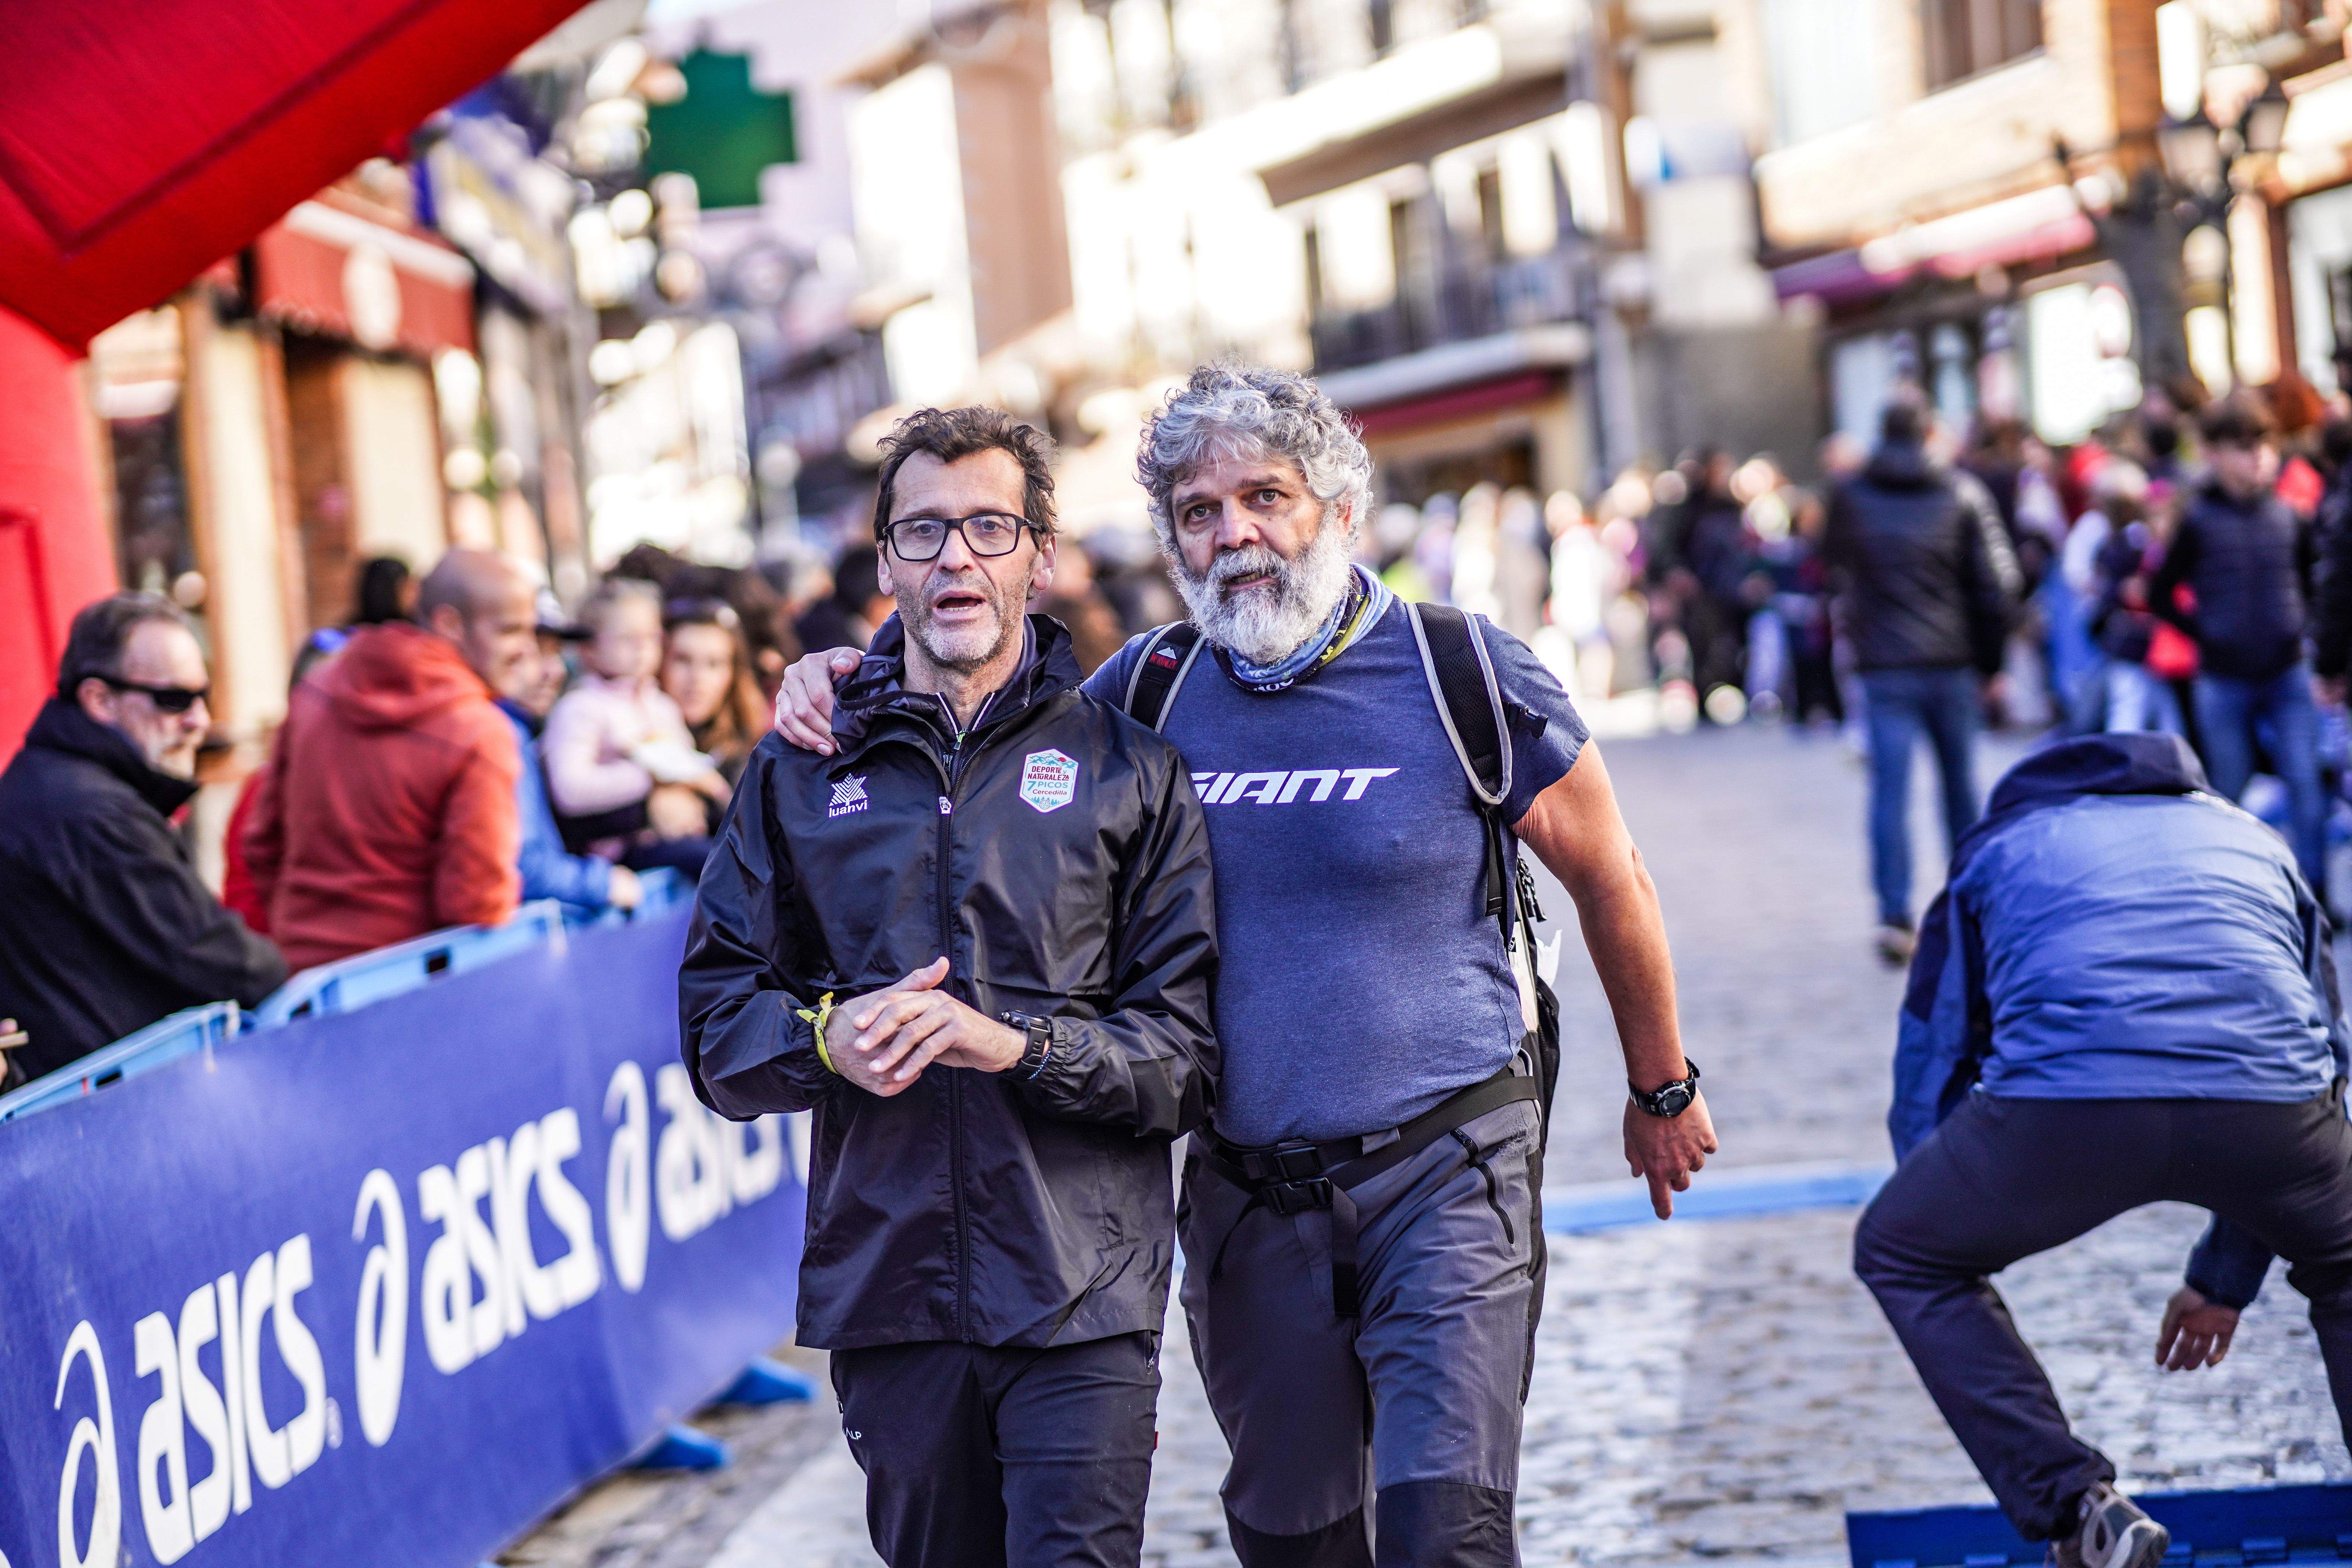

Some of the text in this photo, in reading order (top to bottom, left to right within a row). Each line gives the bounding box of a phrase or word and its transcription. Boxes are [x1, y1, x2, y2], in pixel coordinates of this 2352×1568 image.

[829, 799, 867, 818] luanvi
[1027, 781, 1037, 791] 7
[416, 1106, 601, 1376] asics
[134, 1233, 326, 1566] asics
